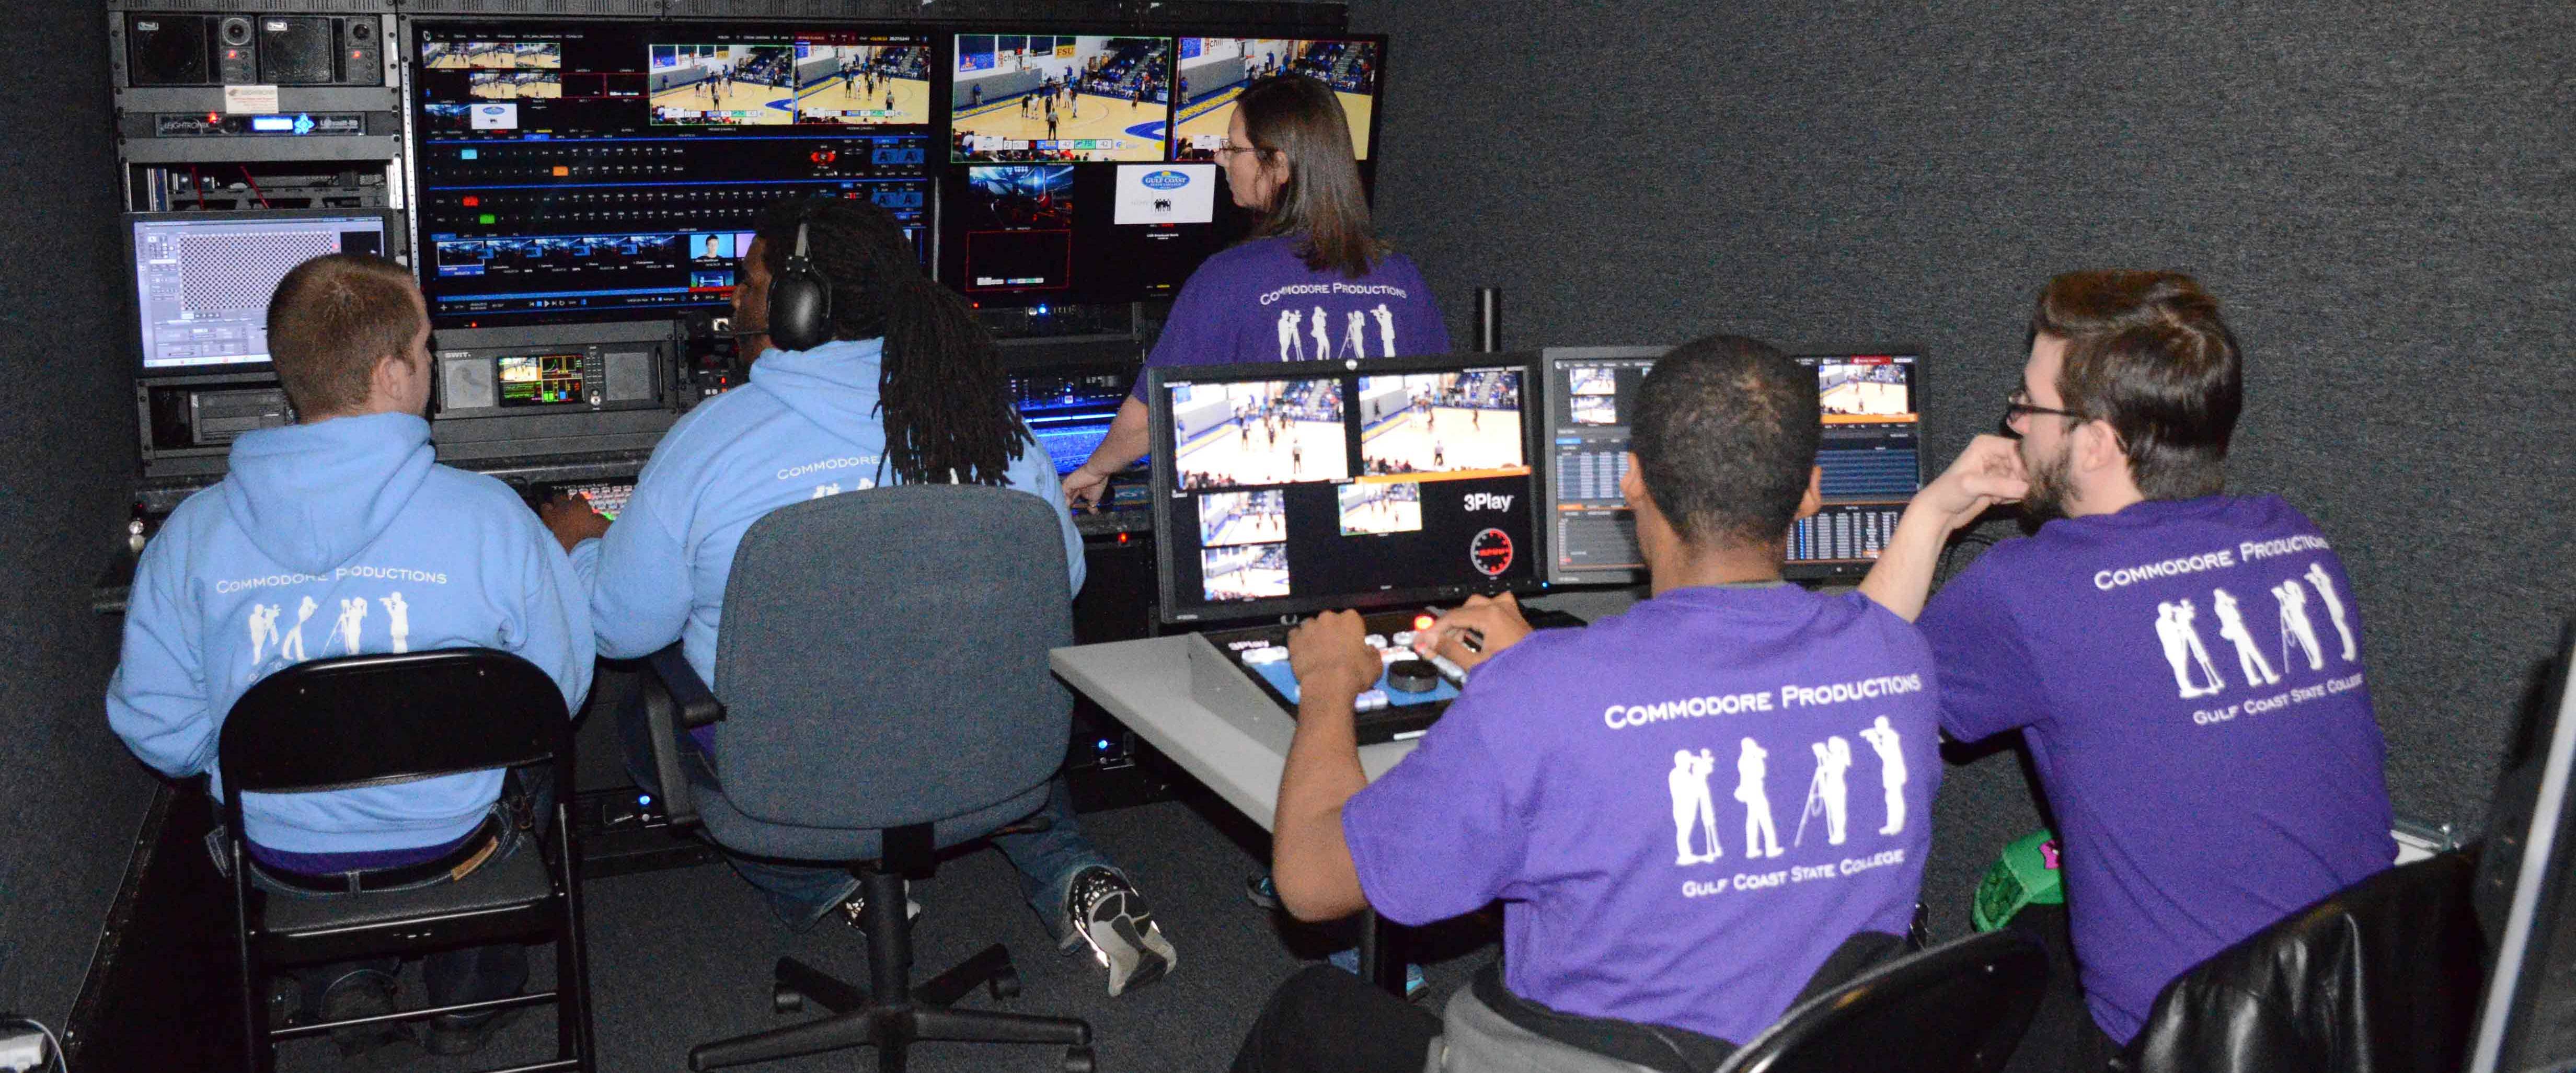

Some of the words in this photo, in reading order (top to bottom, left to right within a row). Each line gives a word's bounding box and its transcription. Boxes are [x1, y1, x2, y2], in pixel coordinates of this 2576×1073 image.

[1056, 47, 1074, 56] FSU
[1332, 282, 1406, 299] PRODUCTIONS
[777, 455, 880, 480] COMMODORE
[1464, 492, 1512, 513] 3Play
[336, 566, 447, 584] PODUCTIONS
[2094, 549, 2235, 591] COMMODORE
[2239, 535, 2330, 562] PRODUCTION
[1604, 690, 1774, 730] COMMODORE
[1781, 673, 1923, 709] PRODUCTIONS
[2192, 705, 2239, 725] GULF
[2243, 695, 2289, 716] COAST
[2290, 683, 2326, 703] STATE
[1682, 878, 1729, 898] GULF
[1732, 870, 1787, 892] COAST
[1790, 862, 1836, 882] STATE
[1839, 848, 1906, 876] COLLEGE
